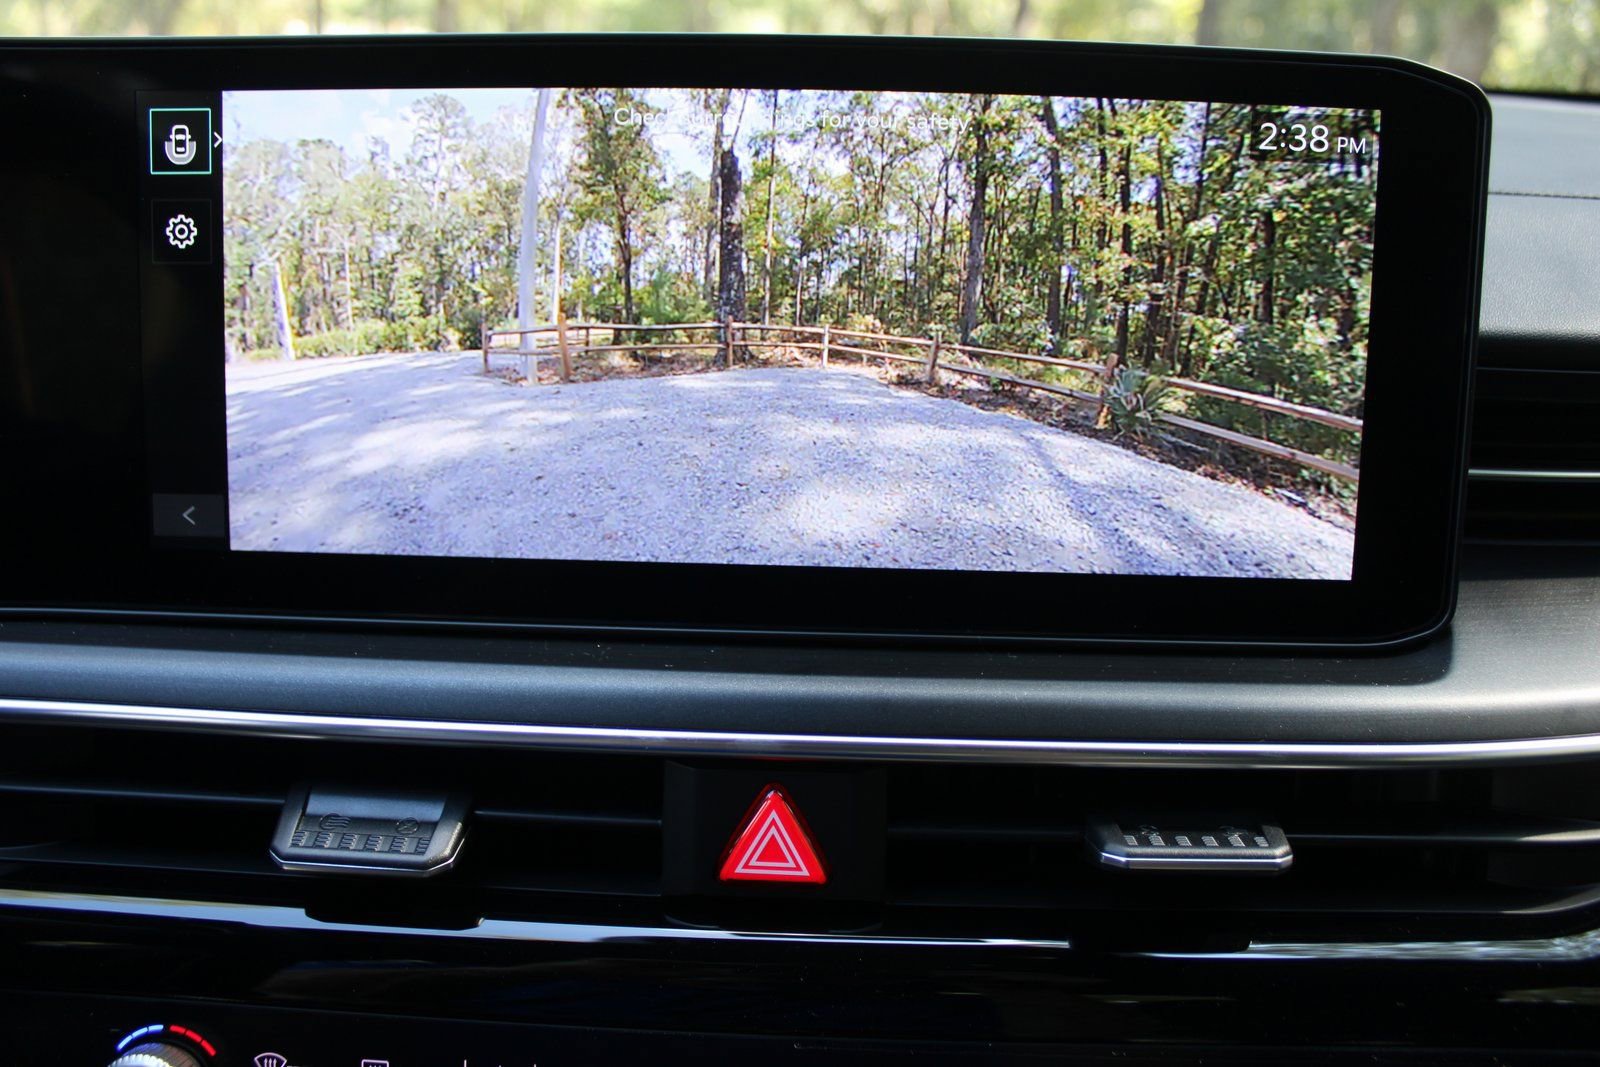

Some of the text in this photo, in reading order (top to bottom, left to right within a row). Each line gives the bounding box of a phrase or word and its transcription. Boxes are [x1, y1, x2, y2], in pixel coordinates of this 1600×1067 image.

[821, 110, 851, 128] for
[856, 115, 898, 131] your
[907, 112, 973, 134] safety.
[1259, 122, 1366, 153] 2:38 PM
